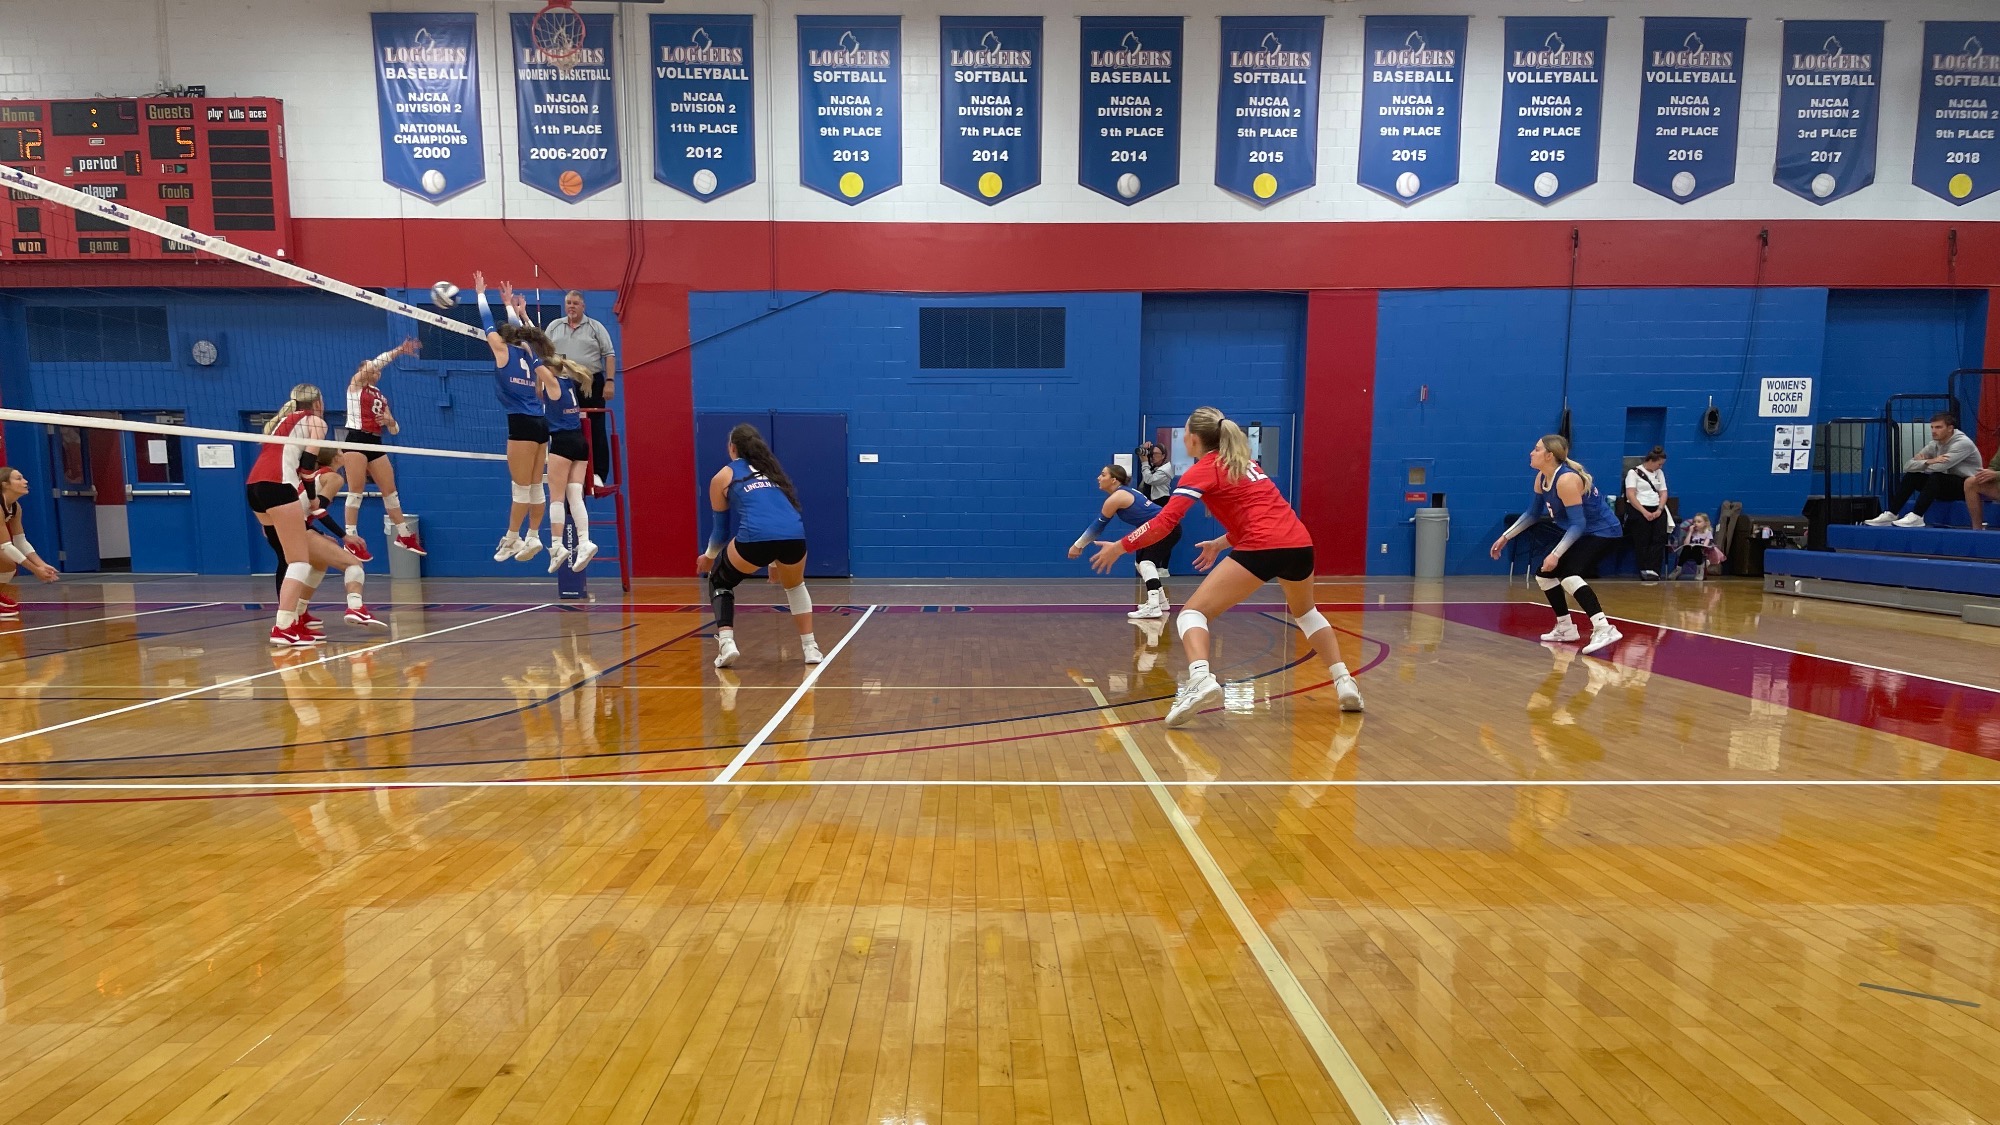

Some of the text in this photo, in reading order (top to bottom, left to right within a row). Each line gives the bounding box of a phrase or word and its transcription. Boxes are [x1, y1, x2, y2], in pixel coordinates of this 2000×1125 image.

[385, 47, 467, 63] LOGGERS
[662, 46, 743, 63] LOGGERS
[809, 50, 890, 66] LOGGERS
[951, 50, 1031, 66] LOGGERS
[1091, 50, 1172, 66] LOGGERS
[1230, 51, 1311, 67] LOGGERS
[1374, 50, 1455, 66] LOGGERS
[1513, 51, 1594, 67] LOGGERS
[1652, 51, 1733, 67] LOGGERS
[1792, 54, 1871, 70] LOGGERS
[1933, 54, 2000, 72] LOGGER
[385, 67, 468, 80] BASEBALL
[518, 66, 610, 80] WOMEN'S BASKETBALL
[657, 67, 748, 80] VOLLEYBALL
[814, 71, 886, 82] SOFTBALL
[955, 71, 1027, 82] SOFTBALL
[1091, 72, 1170, 83] BASEBALL
[1234, 72, 1306, 84] SOFTBALL
[1373, 71, 1453, 82] BASEBALL
[1507, 72, 1598, 83] VOLLEYBALL
[1647, 72, 1736, 83] VOLLEYBALL
[1787, 75, 1874, 85] VOLLEYBALL
[1935, 75, 2000, 86] SOFTBAL
[409, 93, 449, 101] NJCAA
[546, 94, 586, 102] NJCAA
[684, 93, 723, 101] NJCAA
[831, 96, 870, 104] NJCAA
[972, 96, 1010, 104] NJCAA
[1111, 96, 1150, 105] NJCAA
[1250, 97, 1288, 106] NJCAA
[1393, 96, 1432, 104] NJCAA
[1532, 96, 1570, 105] NJCAA
[1671, 96, 1708, 104] NJCAA
[397, 104, 461, 112] DIVISION 2
[671, 103, 735, 113] DIVISION 2
[1811, 99, 1848, 107] NJCAA
[1949, 99, 1987, 108] NJCAA
[2, 107, 35, 121] Home
[150, 104, 190, 120] Guests
[208, 108, 266, 120] plyr kills aces
[534, 105, 599, 114] DIVISION 2
[819, 107, 883, 116] DIVISION 2
[959, 107, 1023, 116] DIVISION 2
[1098, 108, 1162, 116] DIVISION 2
[1237, 108, 1300, 117] DIVISION 2
[1380, 107, 1444, 115] DIVISION 2
[1519, 107, 1582, 116] DIVISION 2
[1658, 107, 1720, 115] DIVISION 2
[1798, 109, 1859, 118] DIVISION 2
[1936, 110, 1998, 119] DIVISION 2
[400, 124, 460, 133] NATIONAL
[534, 125, 601, 134] 11th PLACE
[671, 124, 737, 133] 11th PLACE
[820, 127, 881, 136] 9th PLACE
[961, 127, 1021, 136] 7th PLACE
[1101, 128, 1163, 136] 9th PLACE
[1238, 128, 1297, 137] 5th PLACE
[1381, 127, 1441, 135] 9th PLACE
[1518, 127, 1580, 136] 2nd PLACE
[1656, 127, 1718, 135] 2nd PLACE
[1798, 129, 1856, 138] 3rd PLACE
[1936, 130, 1994, 138] 9th PLACE
[176, 126, 195, 158] 5
[394, 135, 467, 144] CHAMPIONS
[414, 147, 450, 158] 2000
[531, 148, 607, 159] 2006-2007
[686, 147, 722, 158] 2012
[834, 150, 869, 161] 2013
[973, 150, 1008, 161] 2014
[1112, 151, 1147, 162] 2014
[1249, 151, 1283, 162] 2015
[1392, 150, 1426, 161] 2015
[1530, 150, 1565, 161] 2015
[1669, 150, 1702, 160] 2016
[1811, 151, 1841, 162] 2017
[1947, 152, 1979, 163] 2018
[80, 156, 118, 172] period
[162, 185, 190, 198] fouls
[18, 240, 42, 252] won
[90, 239, 119, 252] game
[1767, 380, 1806, 390] WOMEN'S
[1768, 392, 1802, 402] LOCKER
[372, 398, 382, 414] 8
[1772, 404, 1798, 414] ROOM
[744, 482, 772, 492] LINCOLN
